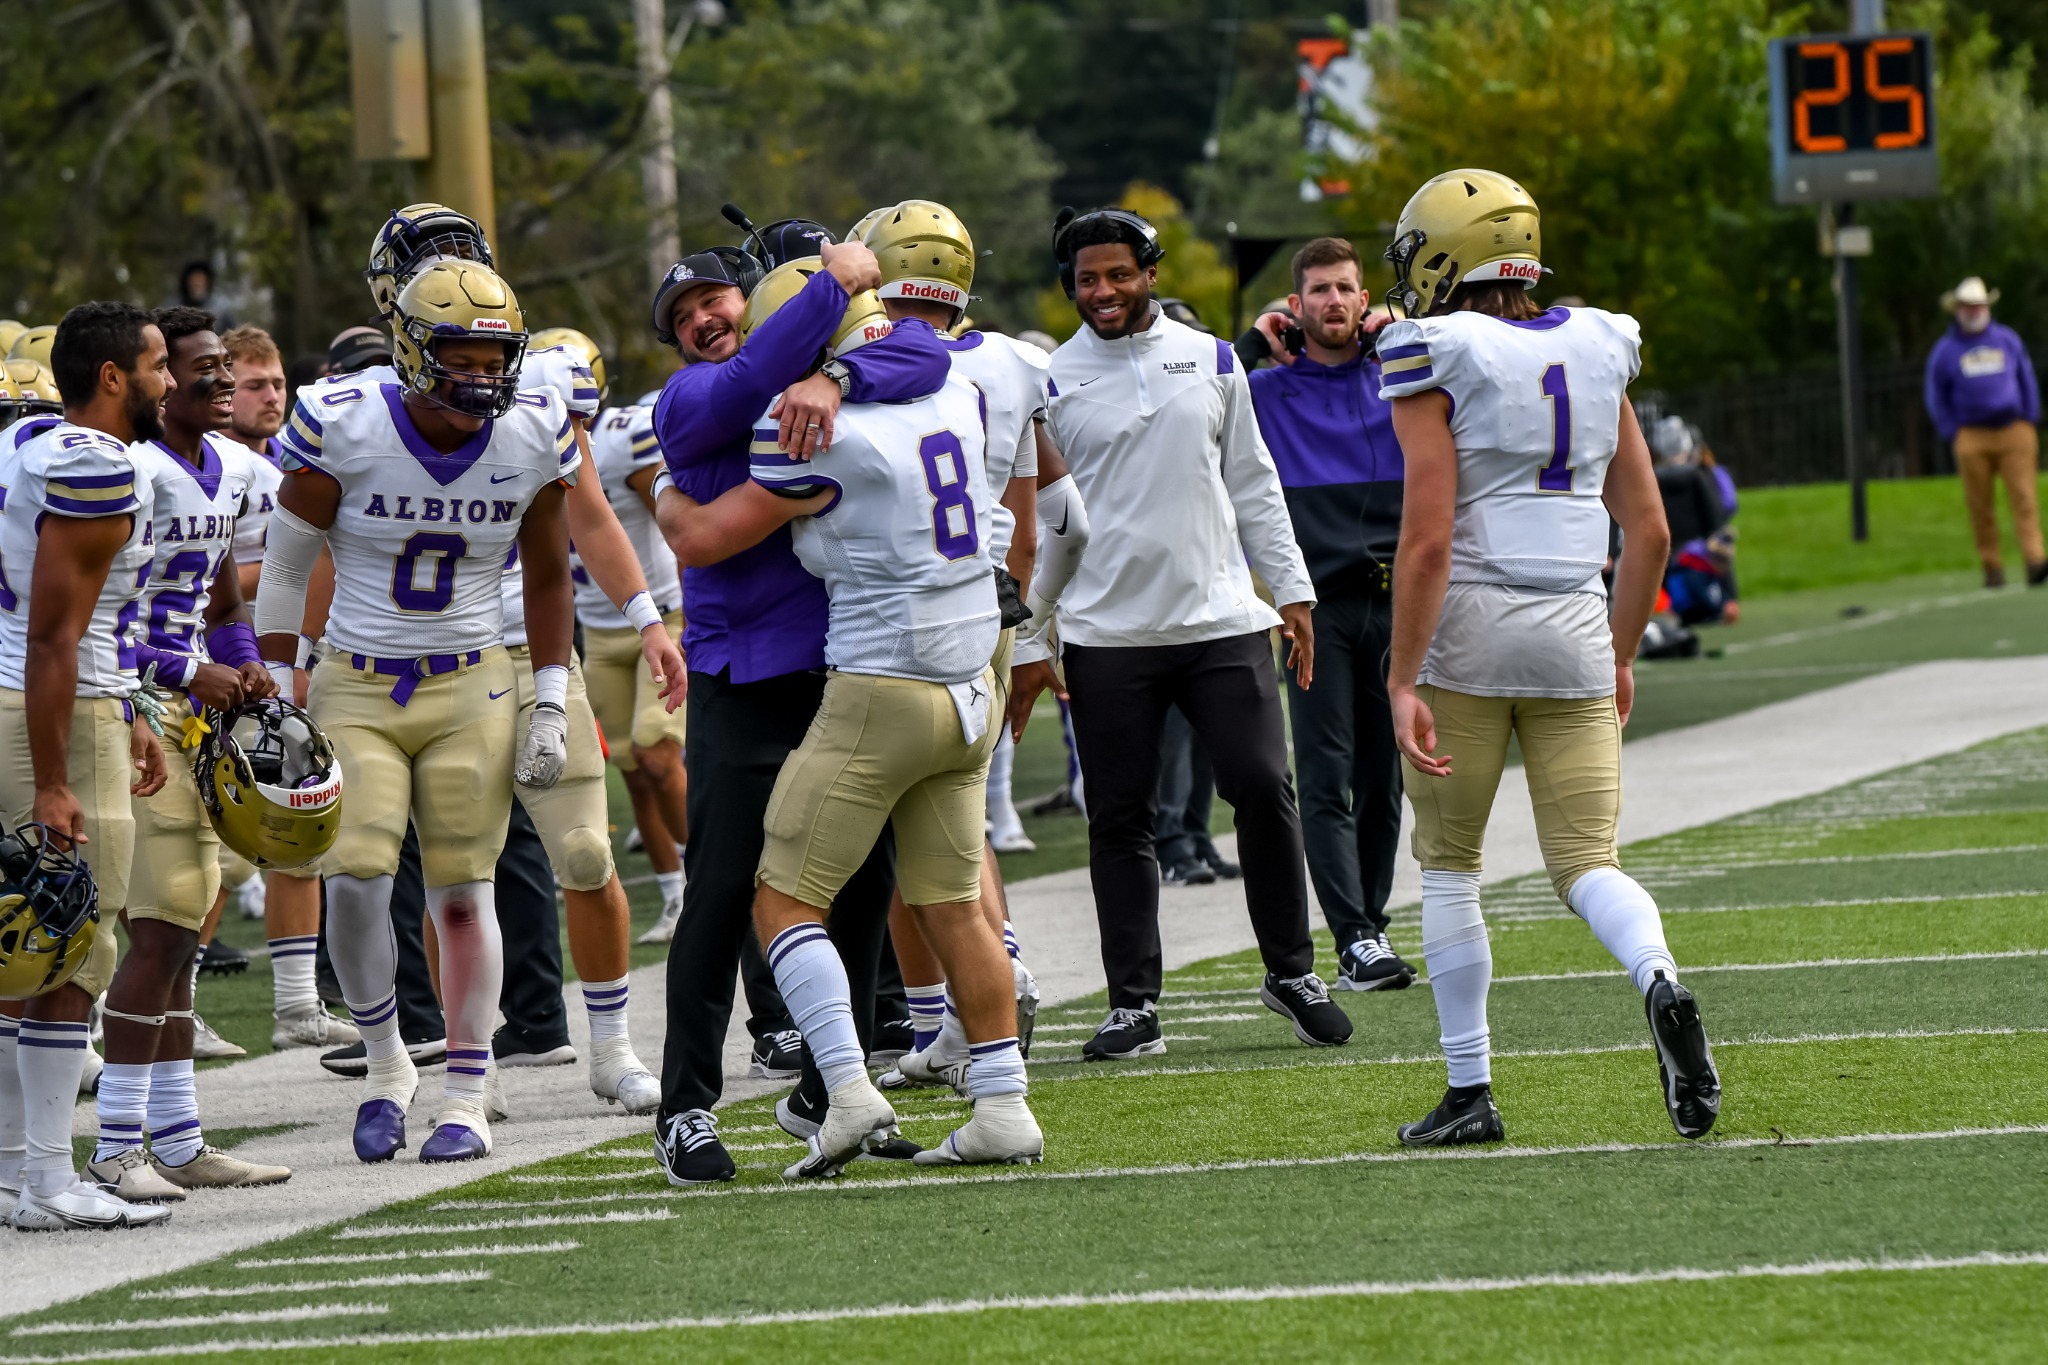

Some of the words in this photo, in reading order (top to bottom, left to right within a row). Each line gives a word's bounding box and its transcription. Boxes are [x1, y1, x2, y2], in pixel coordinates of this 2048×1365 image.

[1794, 38, 1925, 153] 25
[1499, 262, 1541, 281] Ridde
[901, 283, 959, 303] Riddell
[477, 320, 507, 330] Riddell
[864, 323, 894, 342] Ridd
[1163, 361, 1197, 370] ALBION
[1535, 361, 1577, 495] 1
[363, 492, 518, 524] ALBION
[916, 427, 980, 564] 8
[389, 529, 471, 615] 0
[289, 780, 341, 808] Riddell
